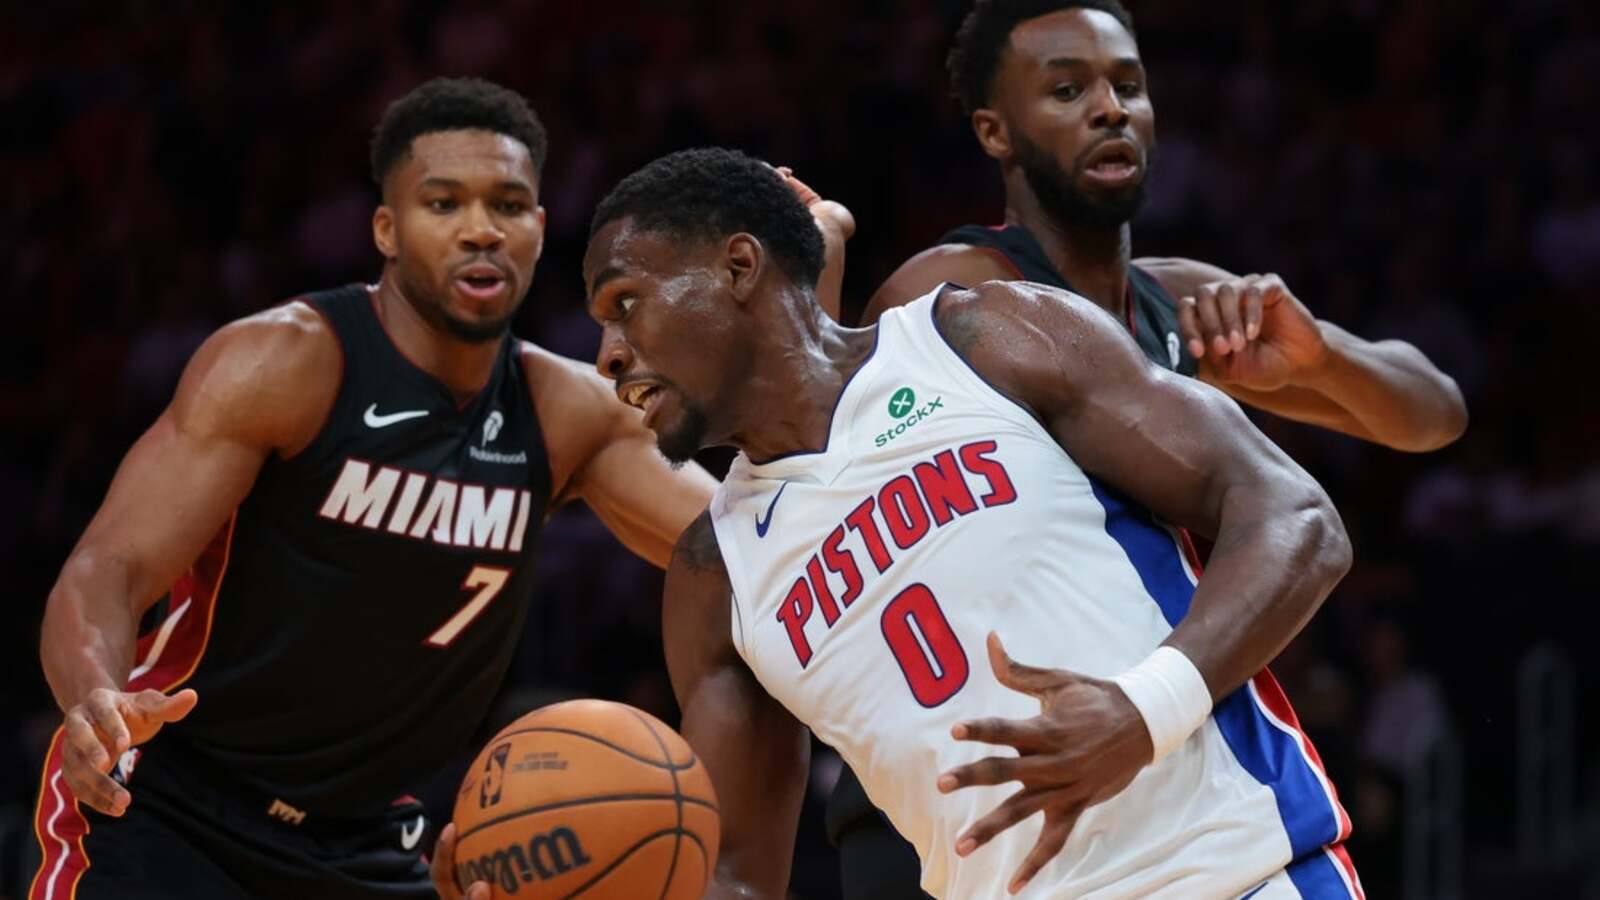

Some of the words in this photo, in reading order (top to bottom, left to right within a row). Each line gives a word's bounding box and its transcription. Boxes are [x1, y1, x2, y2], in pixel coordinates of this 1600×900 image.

[875, 396, 944, 447] StockX
[318, 458, 532, 553] MIAMI
[776, 440, 1018, 669] PISTONS
[424, 565, 512, 647] 7
[880, 582, 969, 709] 0
